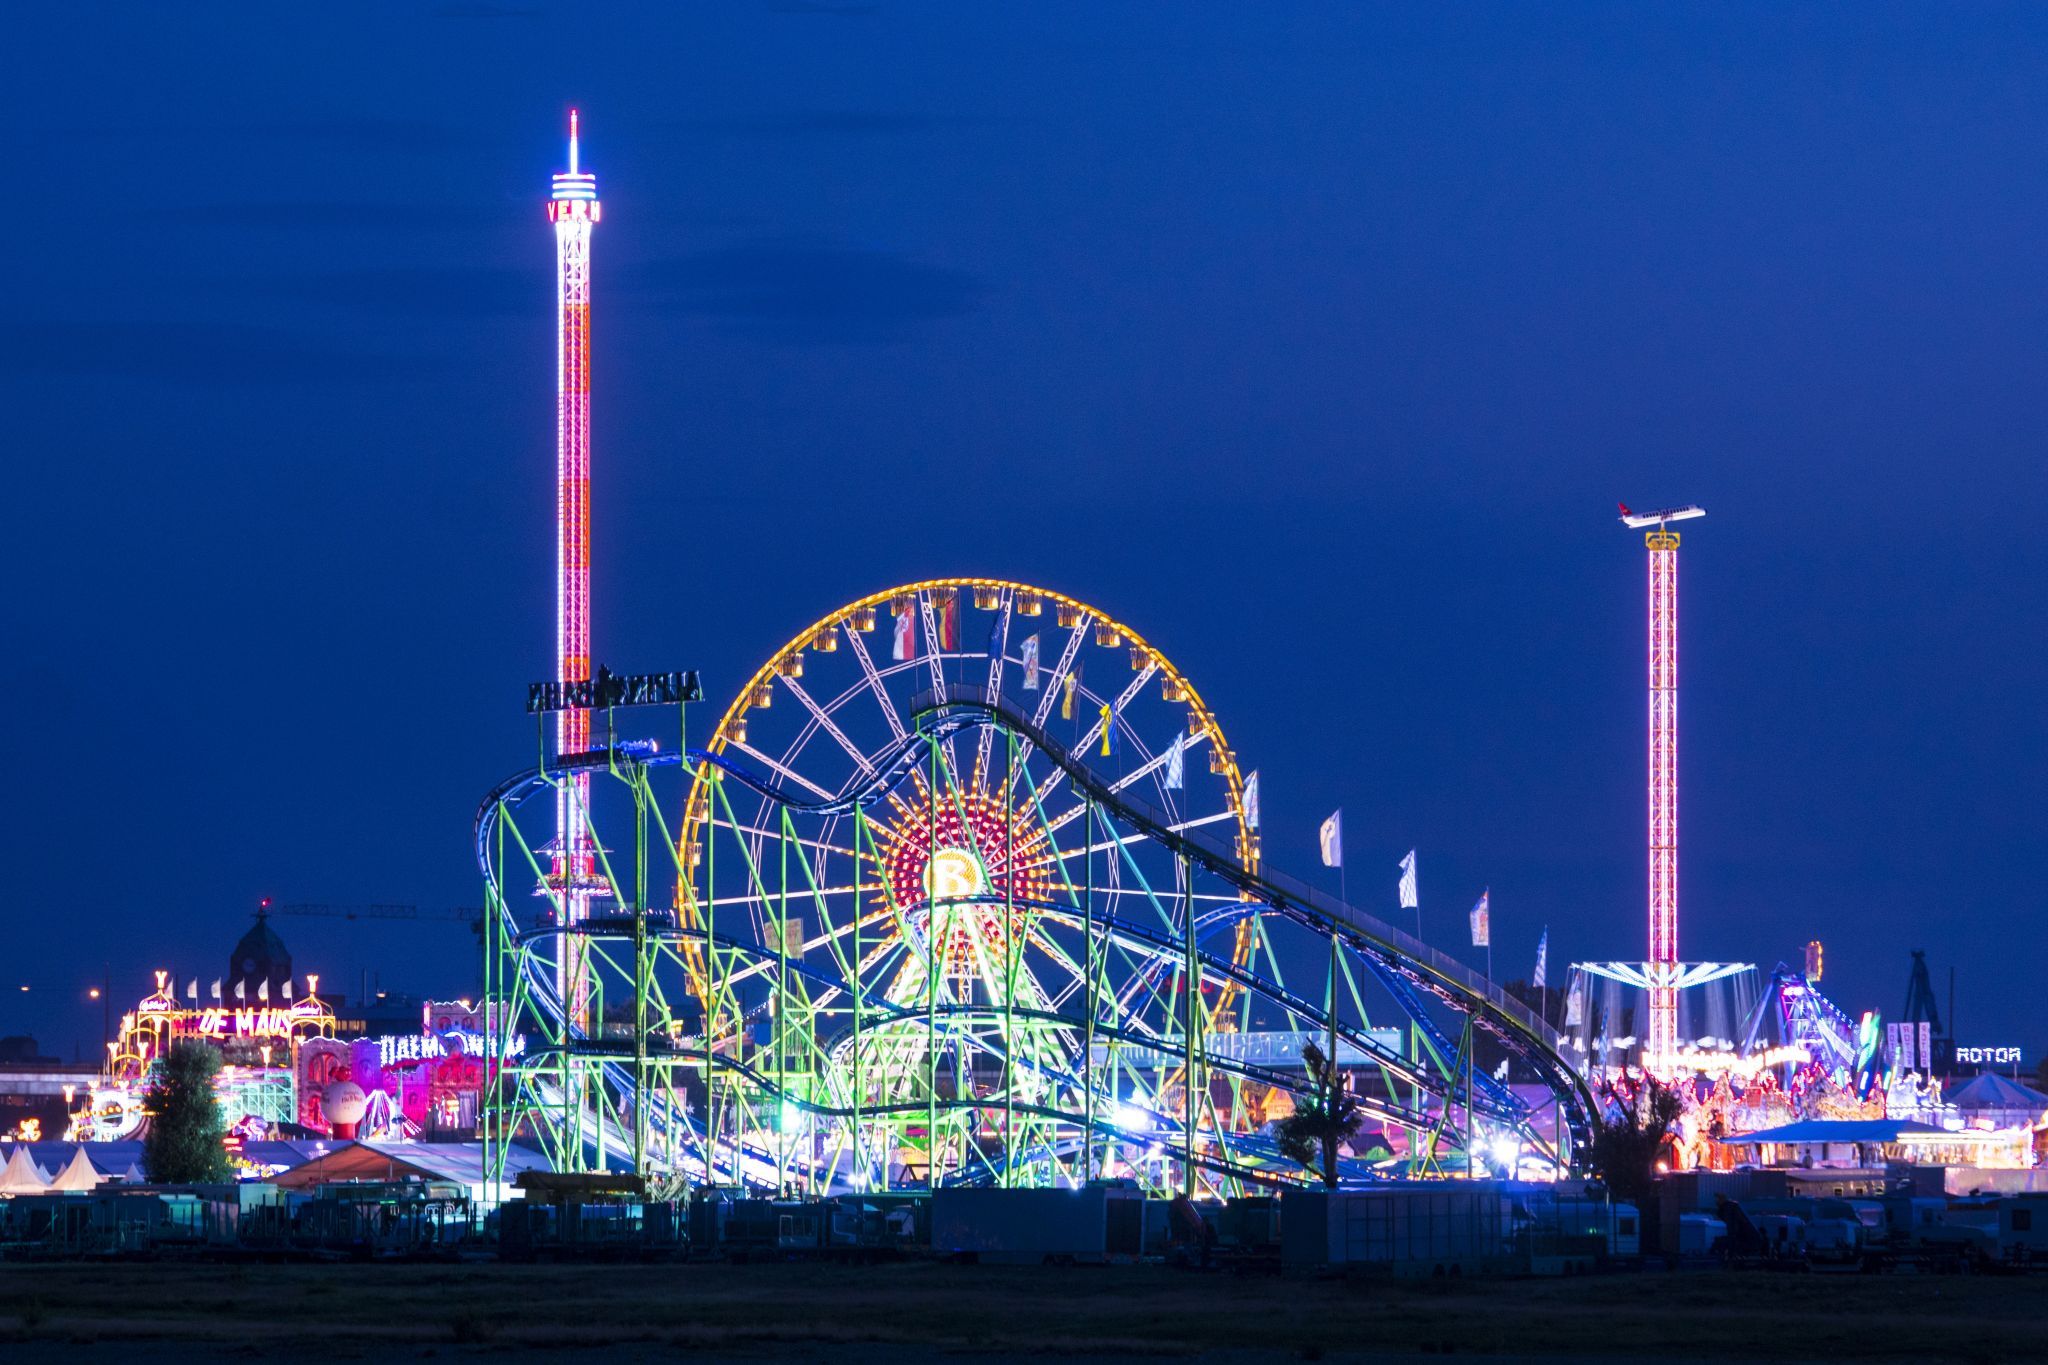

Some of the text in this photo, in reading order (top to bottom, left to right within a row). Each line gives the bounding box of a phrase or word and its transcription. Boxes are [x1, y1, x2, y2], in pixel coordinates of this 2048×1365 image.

[235, 1007, 293, 1039] MAUS
[380, 1032, 526, 1067] DAEMONIM
[1956, 1047, 2021, 1063] ROTOR
